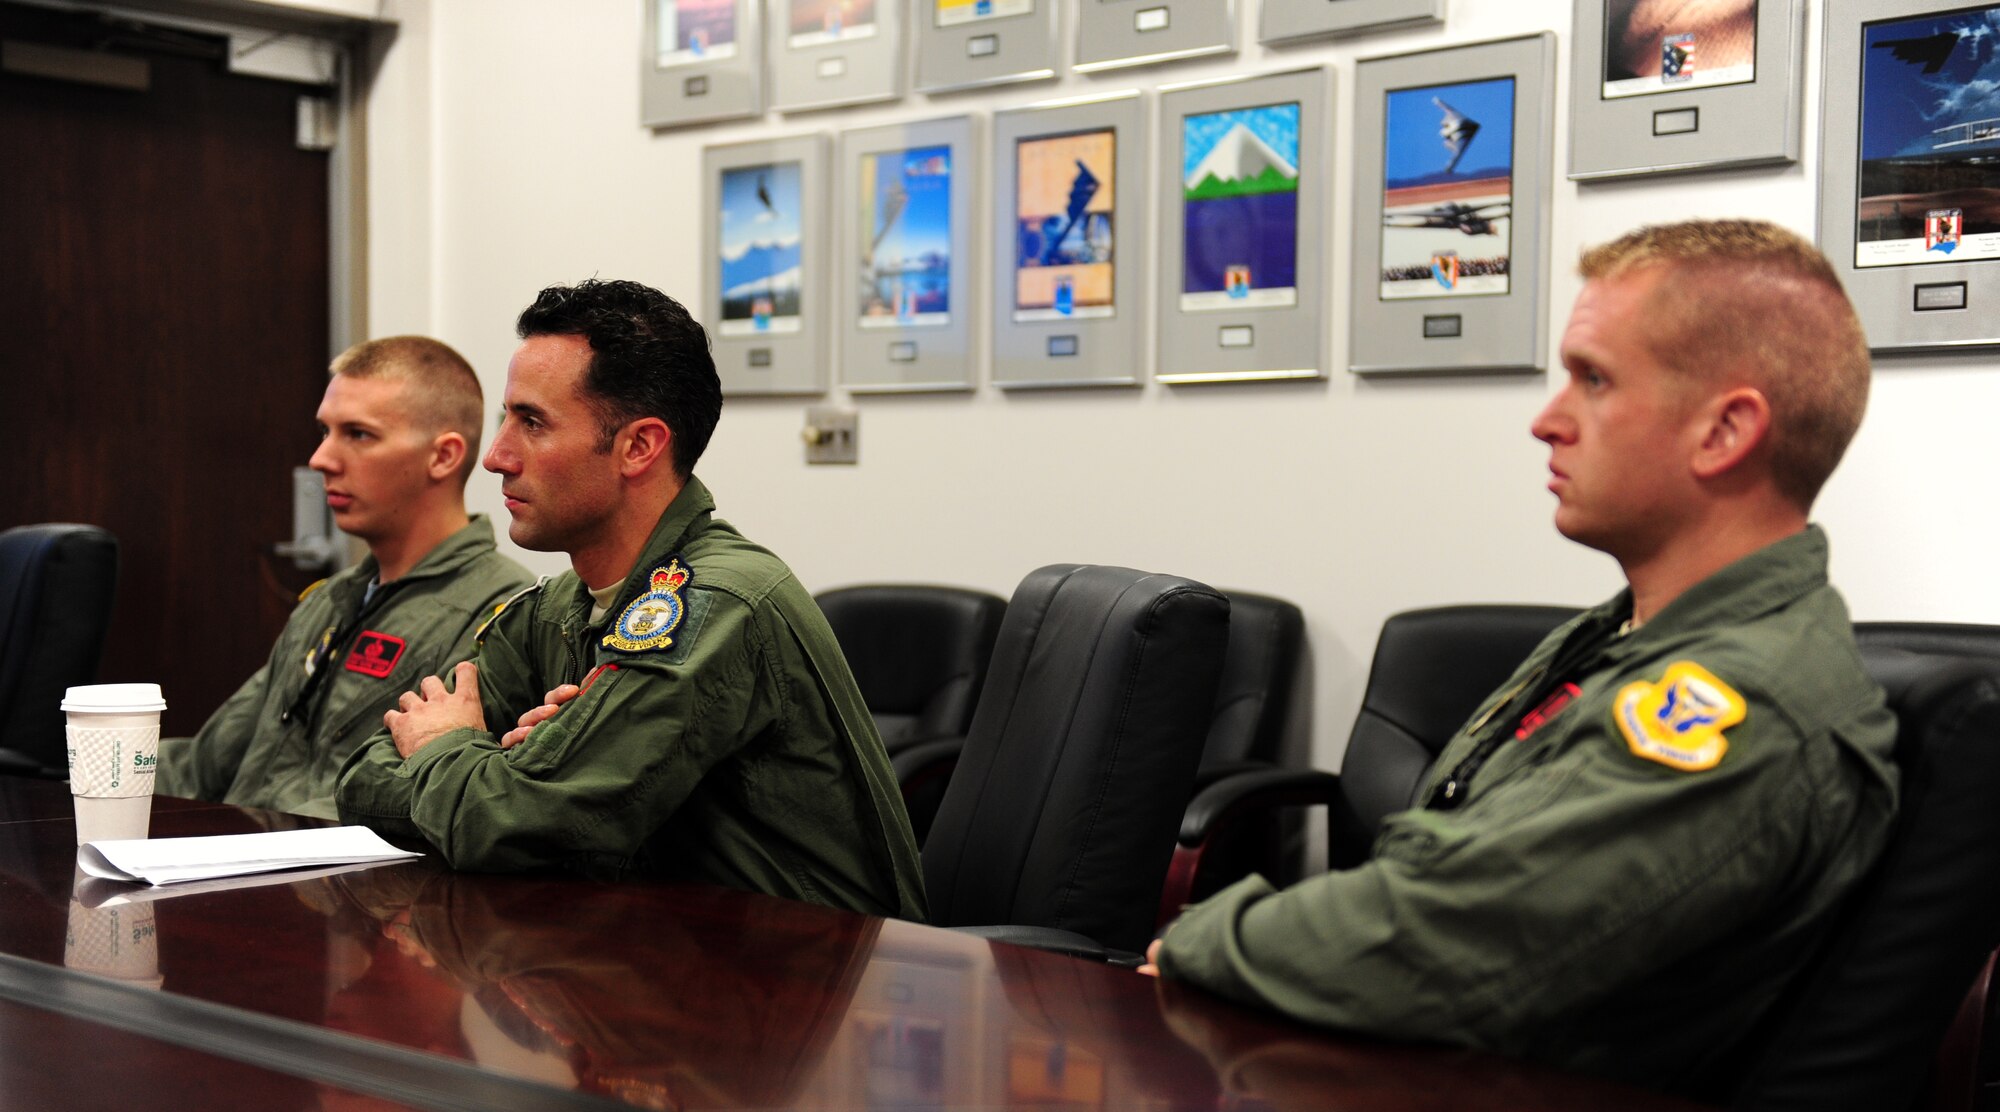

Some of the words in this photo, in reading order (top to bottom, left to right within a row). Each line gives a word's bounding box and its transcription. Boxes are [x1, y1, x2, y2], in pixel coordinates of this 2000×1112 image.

[638, 596, 651, 605] AIR
[653, 594, 674, 605] FORCE
[665, 603, 678, 629] STATION
